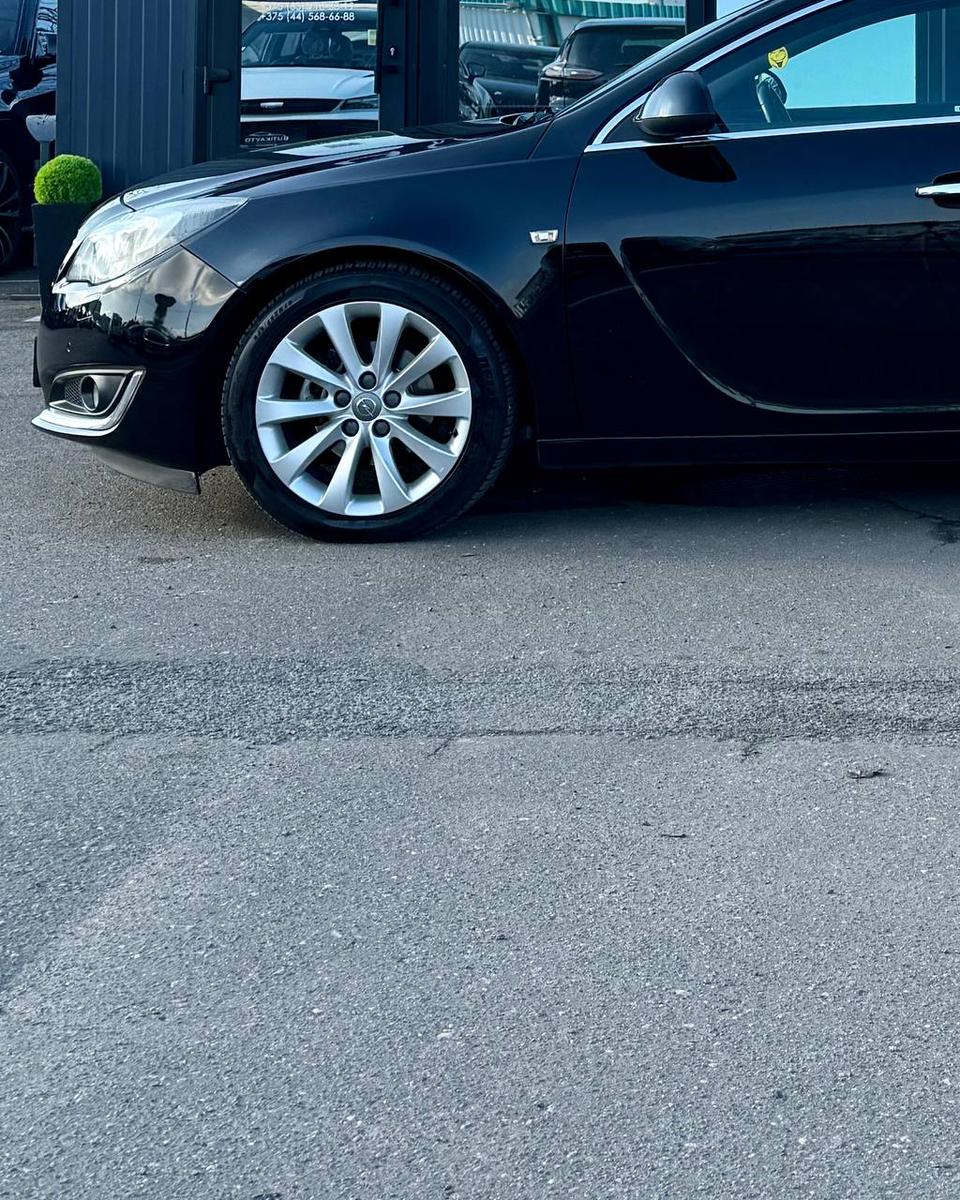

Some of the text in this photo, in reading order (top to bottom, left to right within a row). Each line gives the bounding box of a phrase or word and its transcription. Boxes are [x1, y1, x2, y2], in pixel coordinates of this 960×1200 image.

[260, 11, 356, 23] +375 (44) 568-66-88
